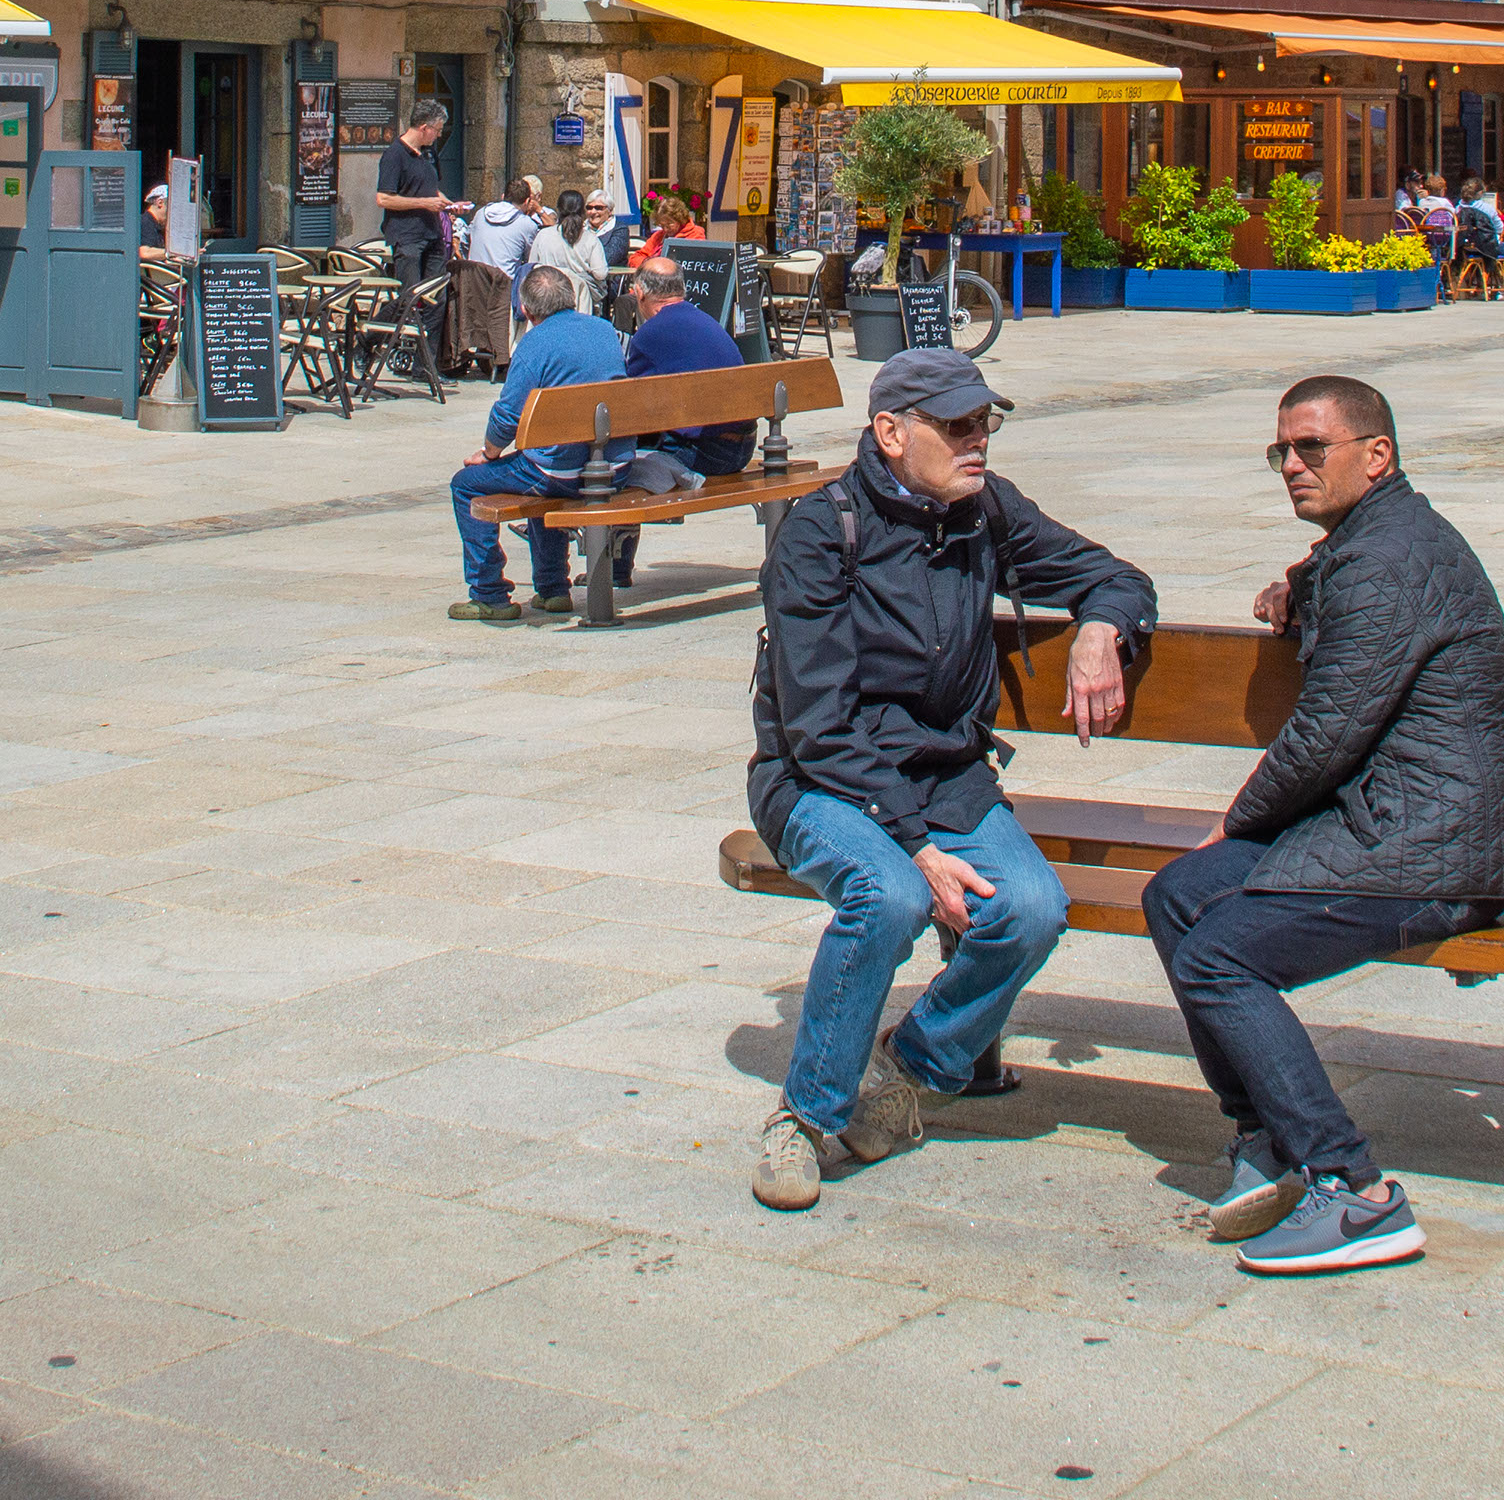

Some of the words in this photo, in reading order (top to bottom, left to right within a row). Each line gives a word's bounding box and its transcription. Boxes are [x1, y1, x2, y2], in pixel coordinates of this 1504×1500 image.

[403, 59, 412, 75] 3
[1097, 86, 1122, 100] Depuis
[1125, 86, 1142, 99] 1893
[1265, 101, 1291, 116] BAR
[1245, 123, 1310, 139] RESTAURANT
[1253, 145, 1304, 160] CREPERIE
[686, 279, 710, 296] BAR
